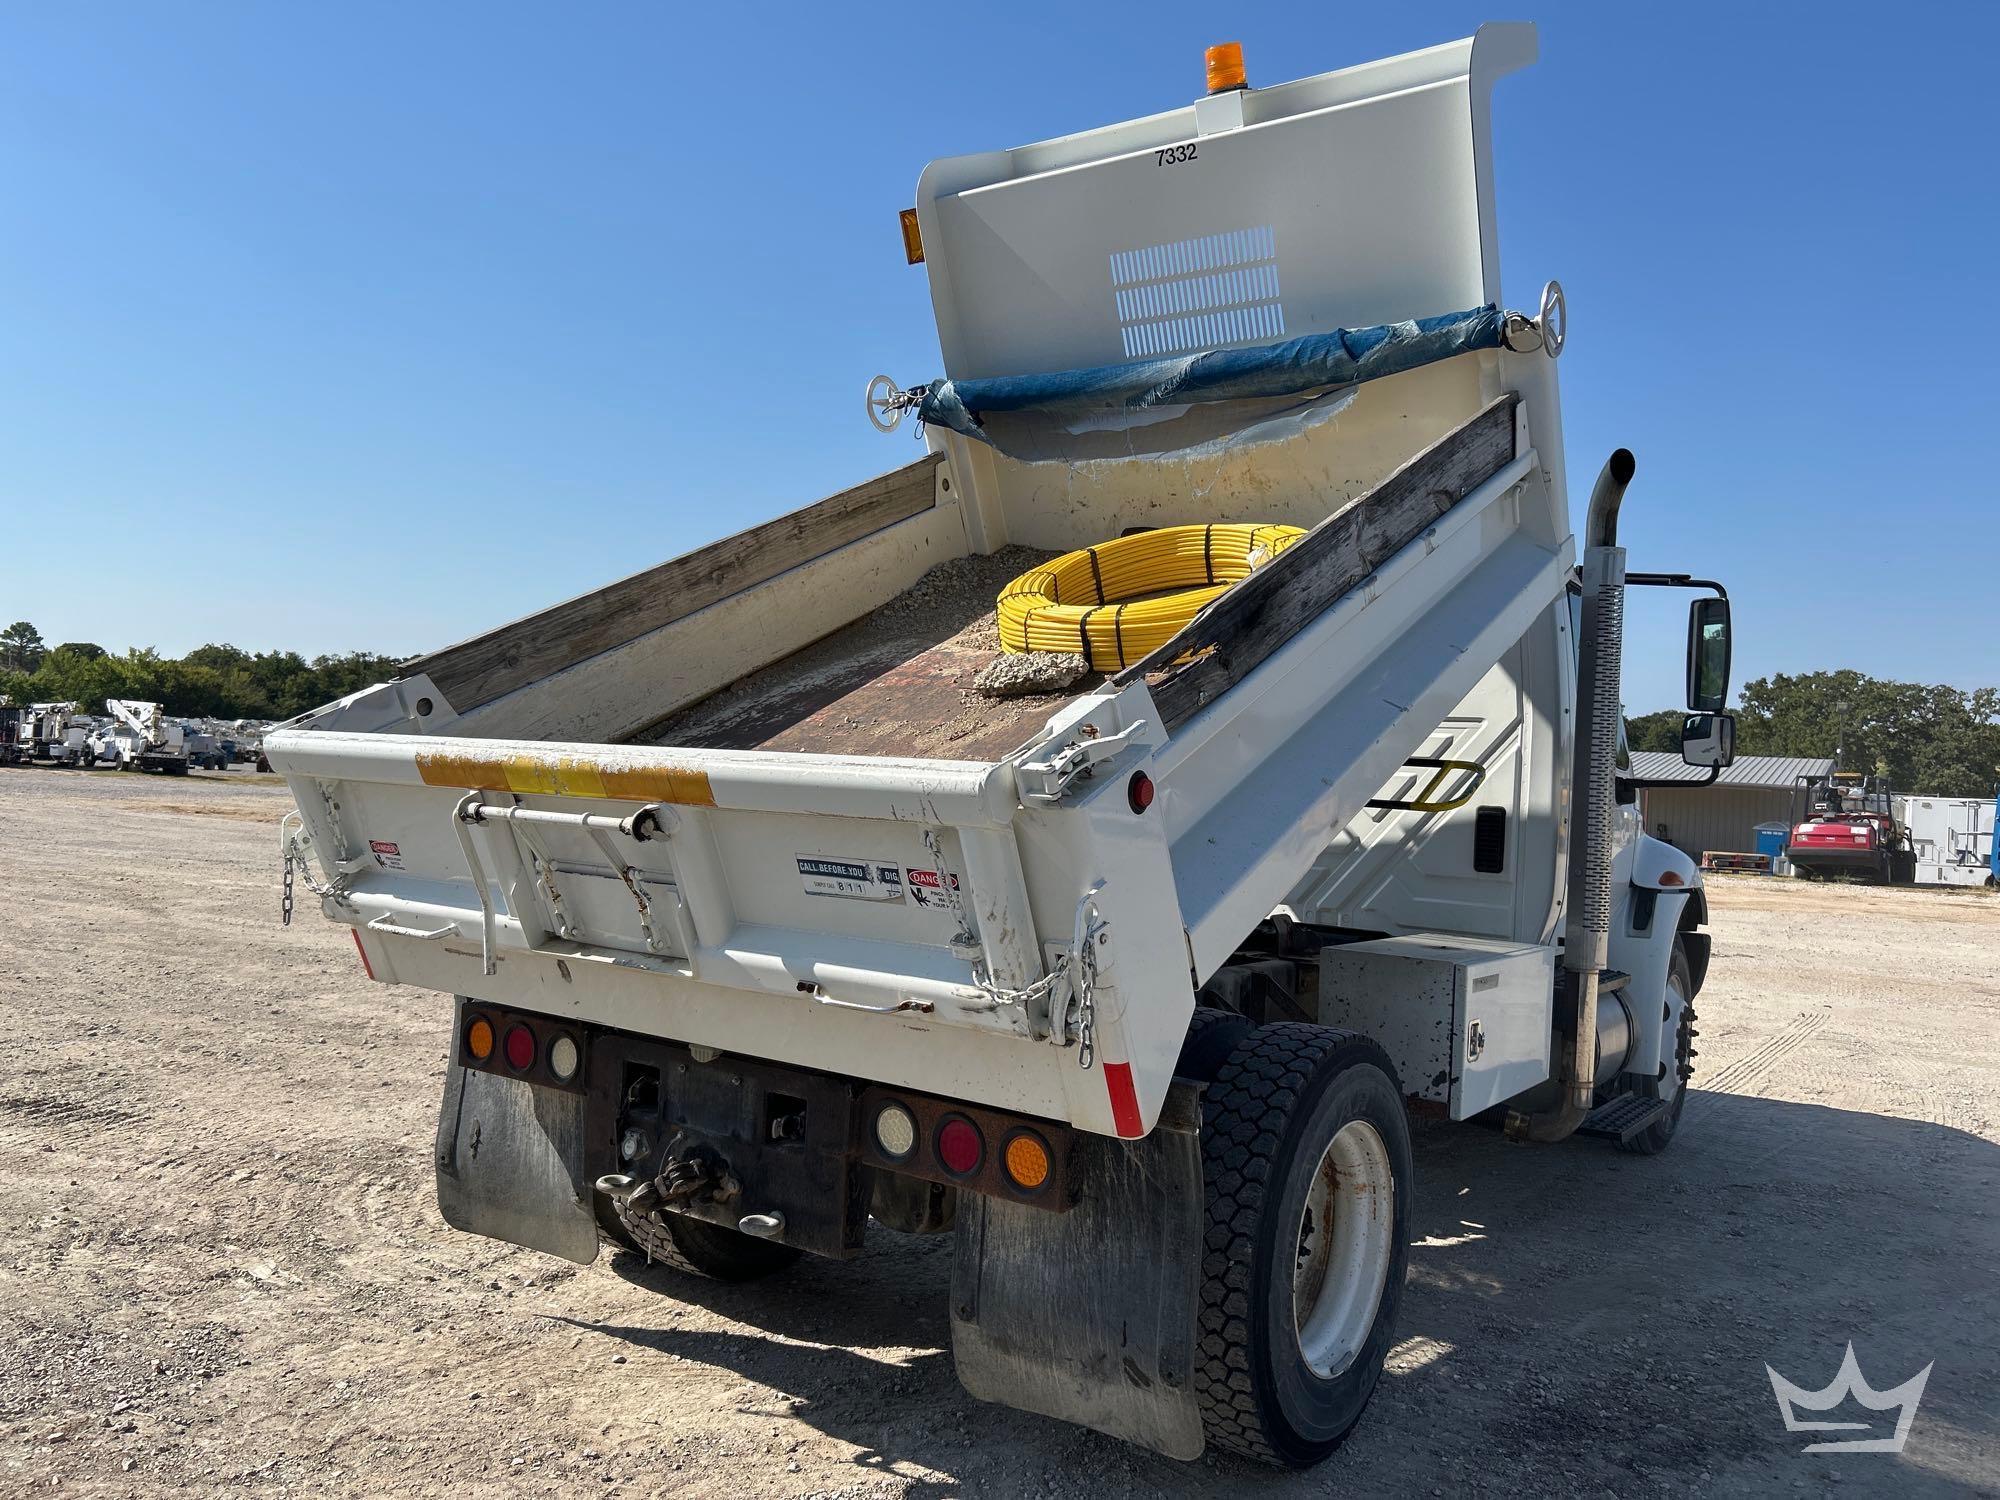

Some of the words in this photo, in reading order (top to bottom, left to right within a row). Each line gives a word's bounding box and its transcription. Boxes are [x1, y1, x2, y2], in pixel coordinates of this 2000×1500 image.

[1155, 143, 1198, 167] 7332
[799, 862, 818, 872] CALL
[819, 864, 847, 875] BEFORE
[847, 867, 863, 877] YOU
